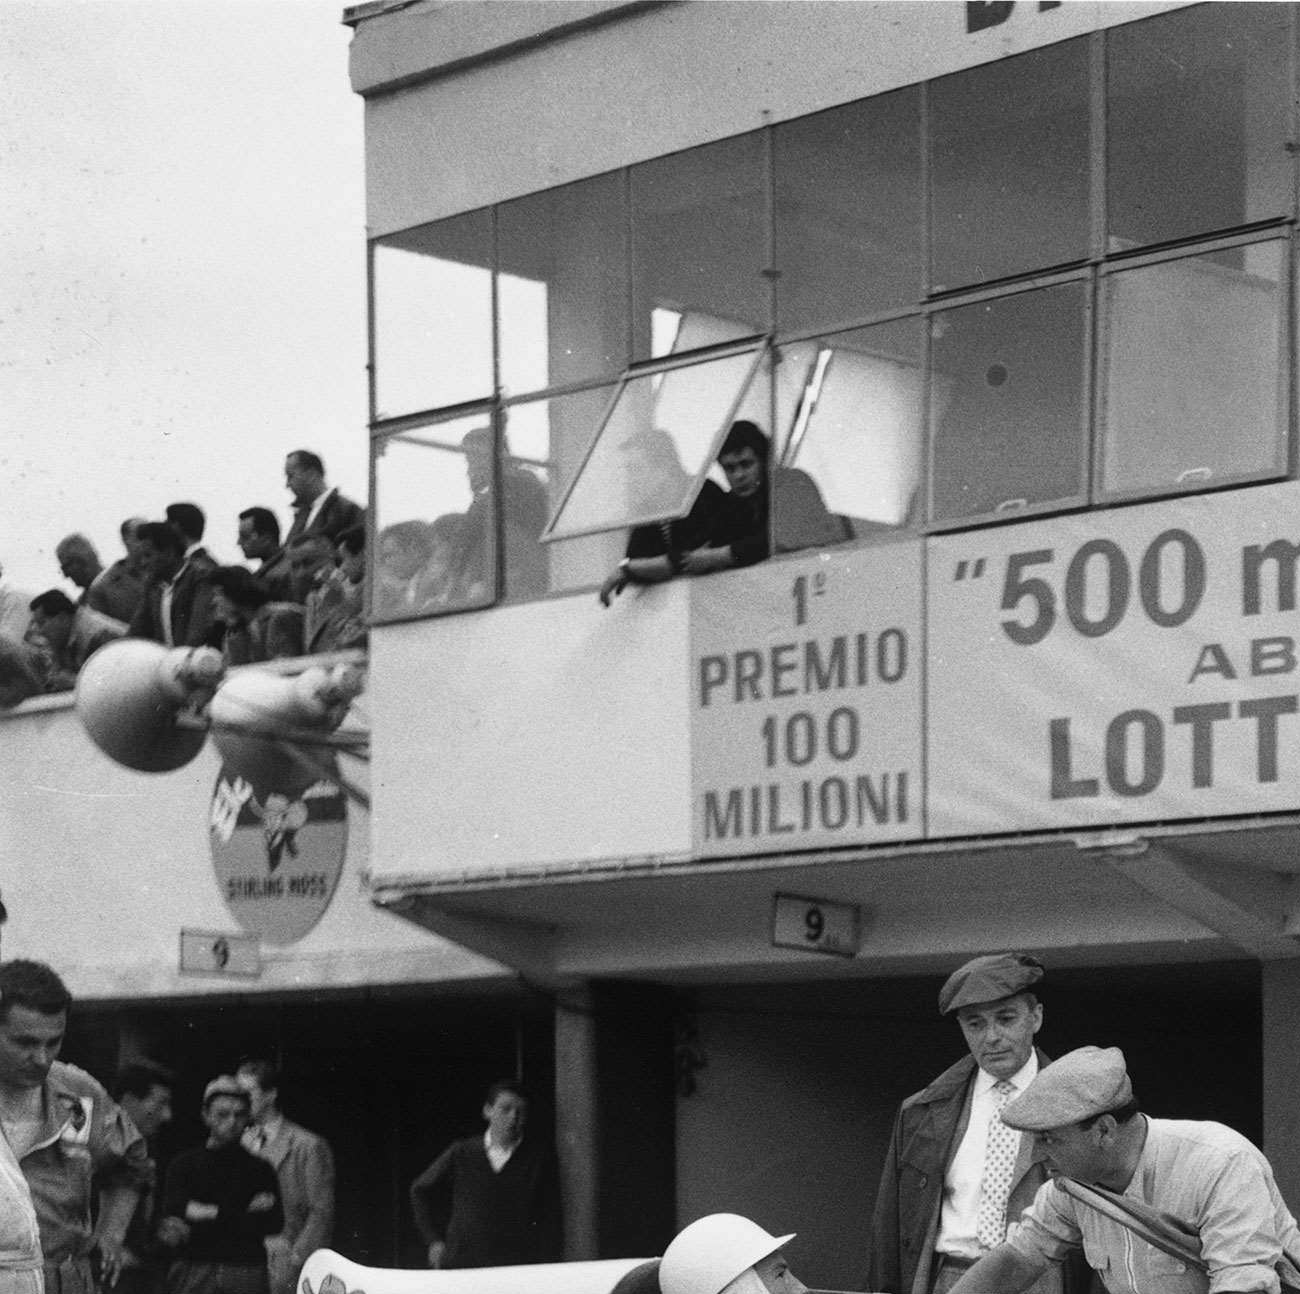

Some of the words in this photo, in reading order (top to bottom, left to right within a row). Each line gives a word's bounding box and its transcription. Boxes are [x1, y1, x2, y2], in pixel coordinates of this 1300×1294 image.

[700, 627, 908, 708] PREMIO
[762, 706, 860, 768] 100
[703, 771, 909, 841] MILIONI
[804, 905, 825, 942] 9
